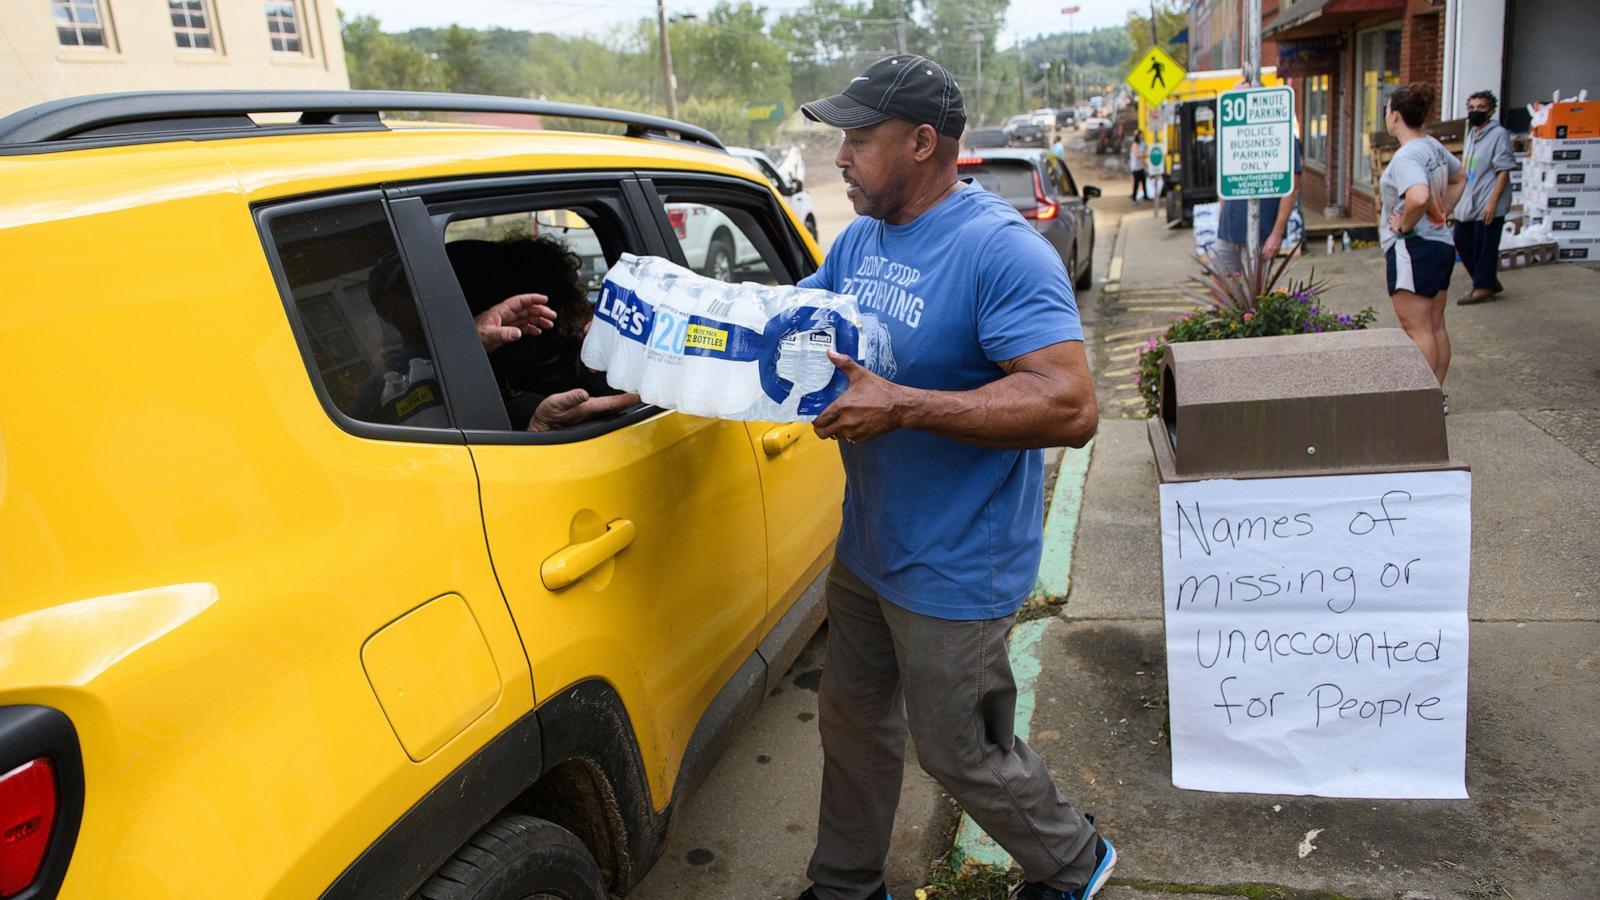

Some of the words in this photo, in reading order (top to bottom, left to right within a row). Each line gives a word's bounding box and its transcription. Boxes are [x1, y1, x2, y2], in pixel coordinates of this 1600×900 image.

[1222, 97, 1246, 122] 30
[1252, 95, 1285, 107] MINUTE
[1249, 107, 1288, 120] PARKING
[1237, 127, 1275, 138] POLICE
[1230, 138, 1282, 150] BUSINESS
[1232, 149, 1279, 160] PARKING
[1240, 161, 1270, 171] ONLY
[1227, 173, 1284, 183] UNAUTHORIZED
[1238, 180, 1274, 188] VEHICLES
[1257, 186, 1281, 194] AWAY
[883, 261, 921, 288] STOP
[692, 335, 724, 347] BOTTLES
[1175, 500, 1314, 559] Names
[1348, 490, 1412, 537] of
[1176, 566, 1357, 614] missing
[1379, 558, 1421, 588] or
[1196, 628, 1442, 669] Unaccounted
[1213, 676, 1286, 725] for
[1307, 683, 1445, 728] People
